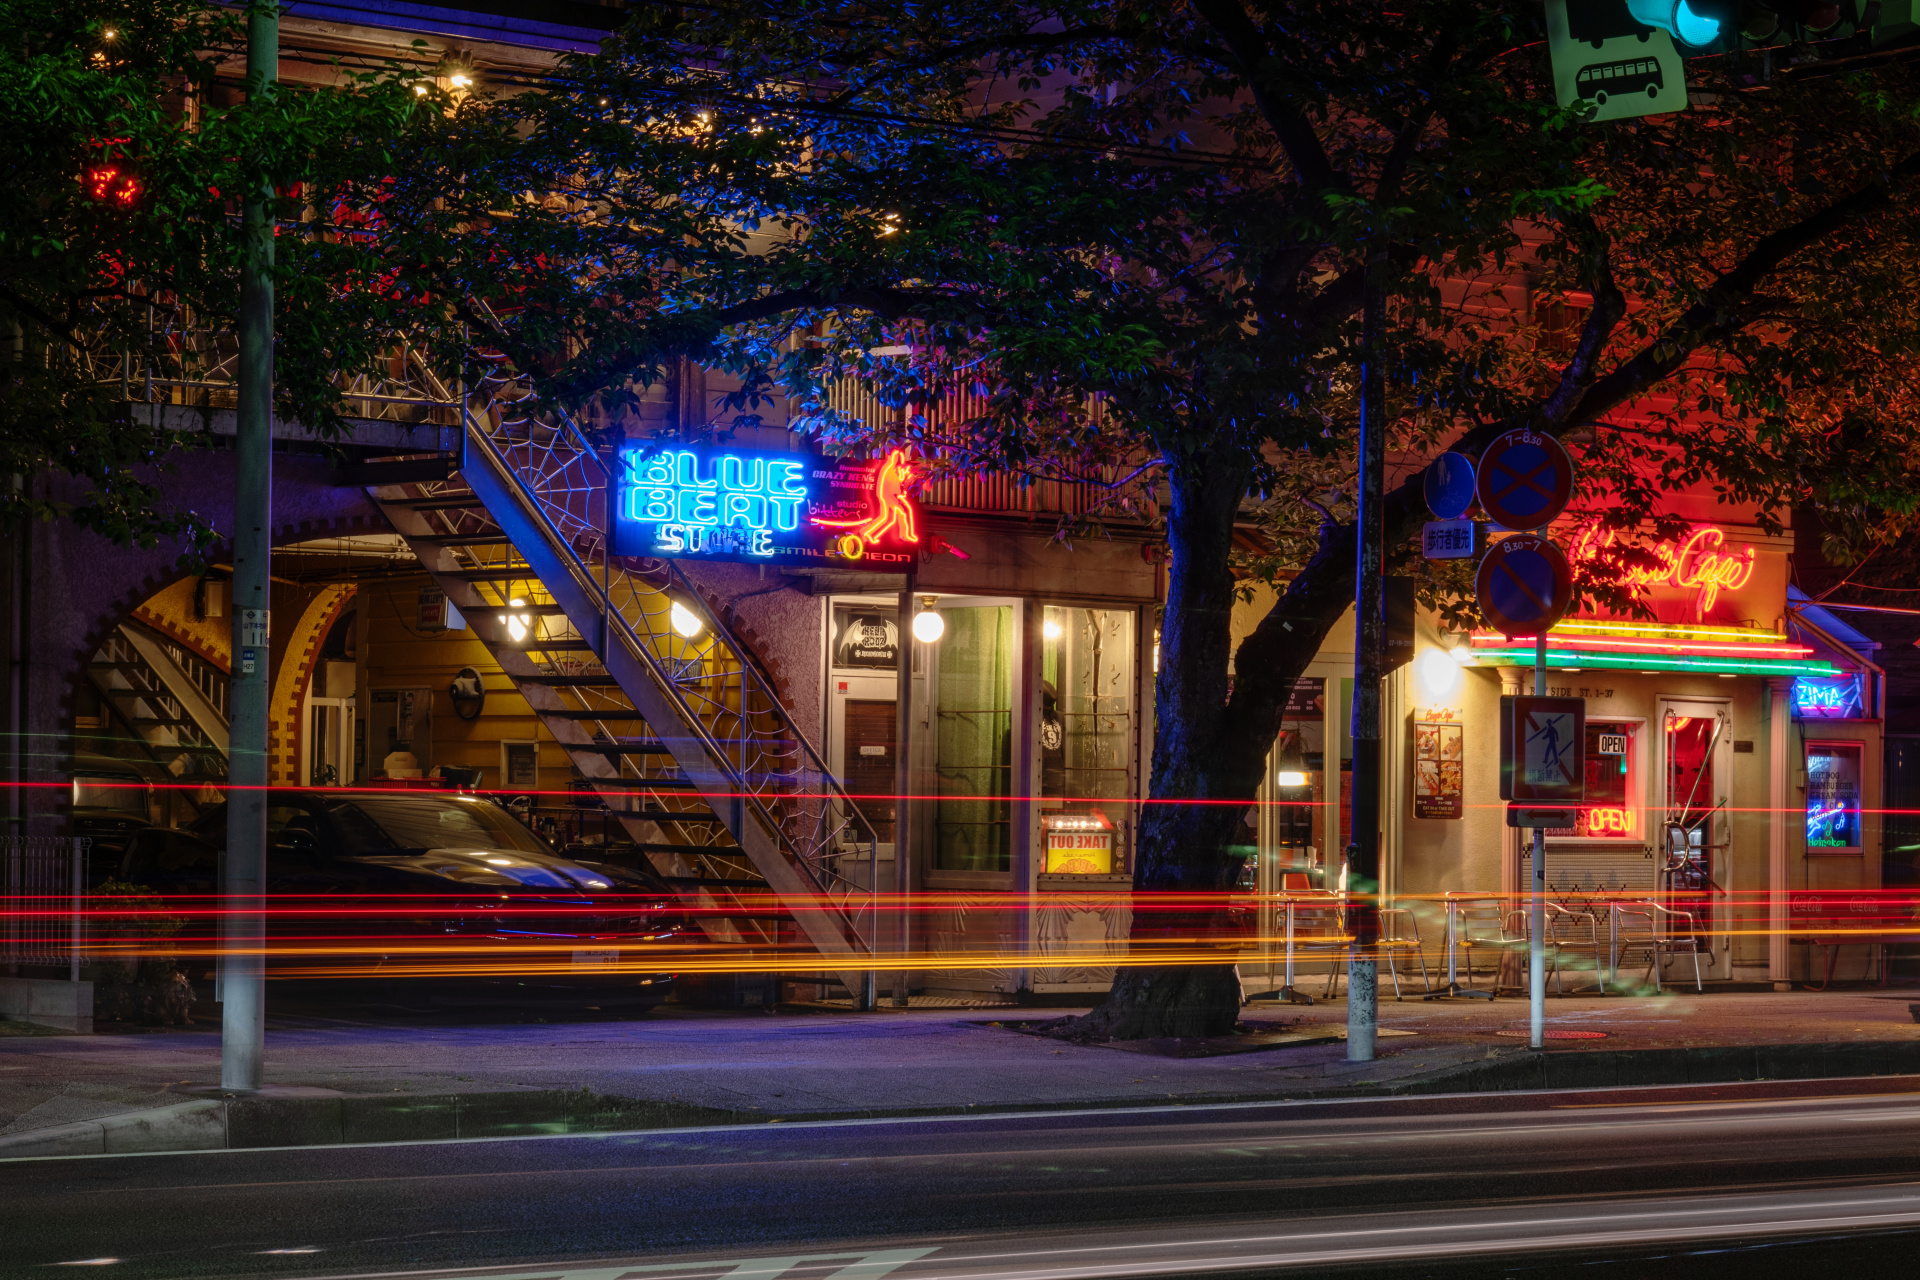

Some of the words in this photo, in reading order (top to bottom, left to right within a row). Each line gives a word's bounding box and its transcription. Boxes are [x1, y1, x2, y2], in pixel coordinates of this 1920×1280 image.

[1505, 431, 1542, 447] 7-8.30
[625, 449, 807, 497] BLUE
[812, 470, 846, 480] CRAZY
[830, 480, 875, 490] SYNDICATE
[625, 485, 805, 531] BEAT
[836, 500, 868, 510] studio
[1427, 529, 1470, 551] 歩行者優先
[1503, 540, 1542, 553] 8.30-7
[772, 546, 836, 558] SMILE
[1550, 687, 1572, 697] SIDE
[1579, 687, 1593, 698] ST.
[1797, 685, 1842, 706] ZIMA
[1601, 736, 1625, 753] OPEN
[1528, 768, 1561, 783] 横断禁止
[1810, 771, 1840, 779] HOTDOG
[1810, 782, 1854, 790] HAMBURGER
[1839, 791, 1859, 799] SODA
[1589, 808, 1631, 832] OPEN
